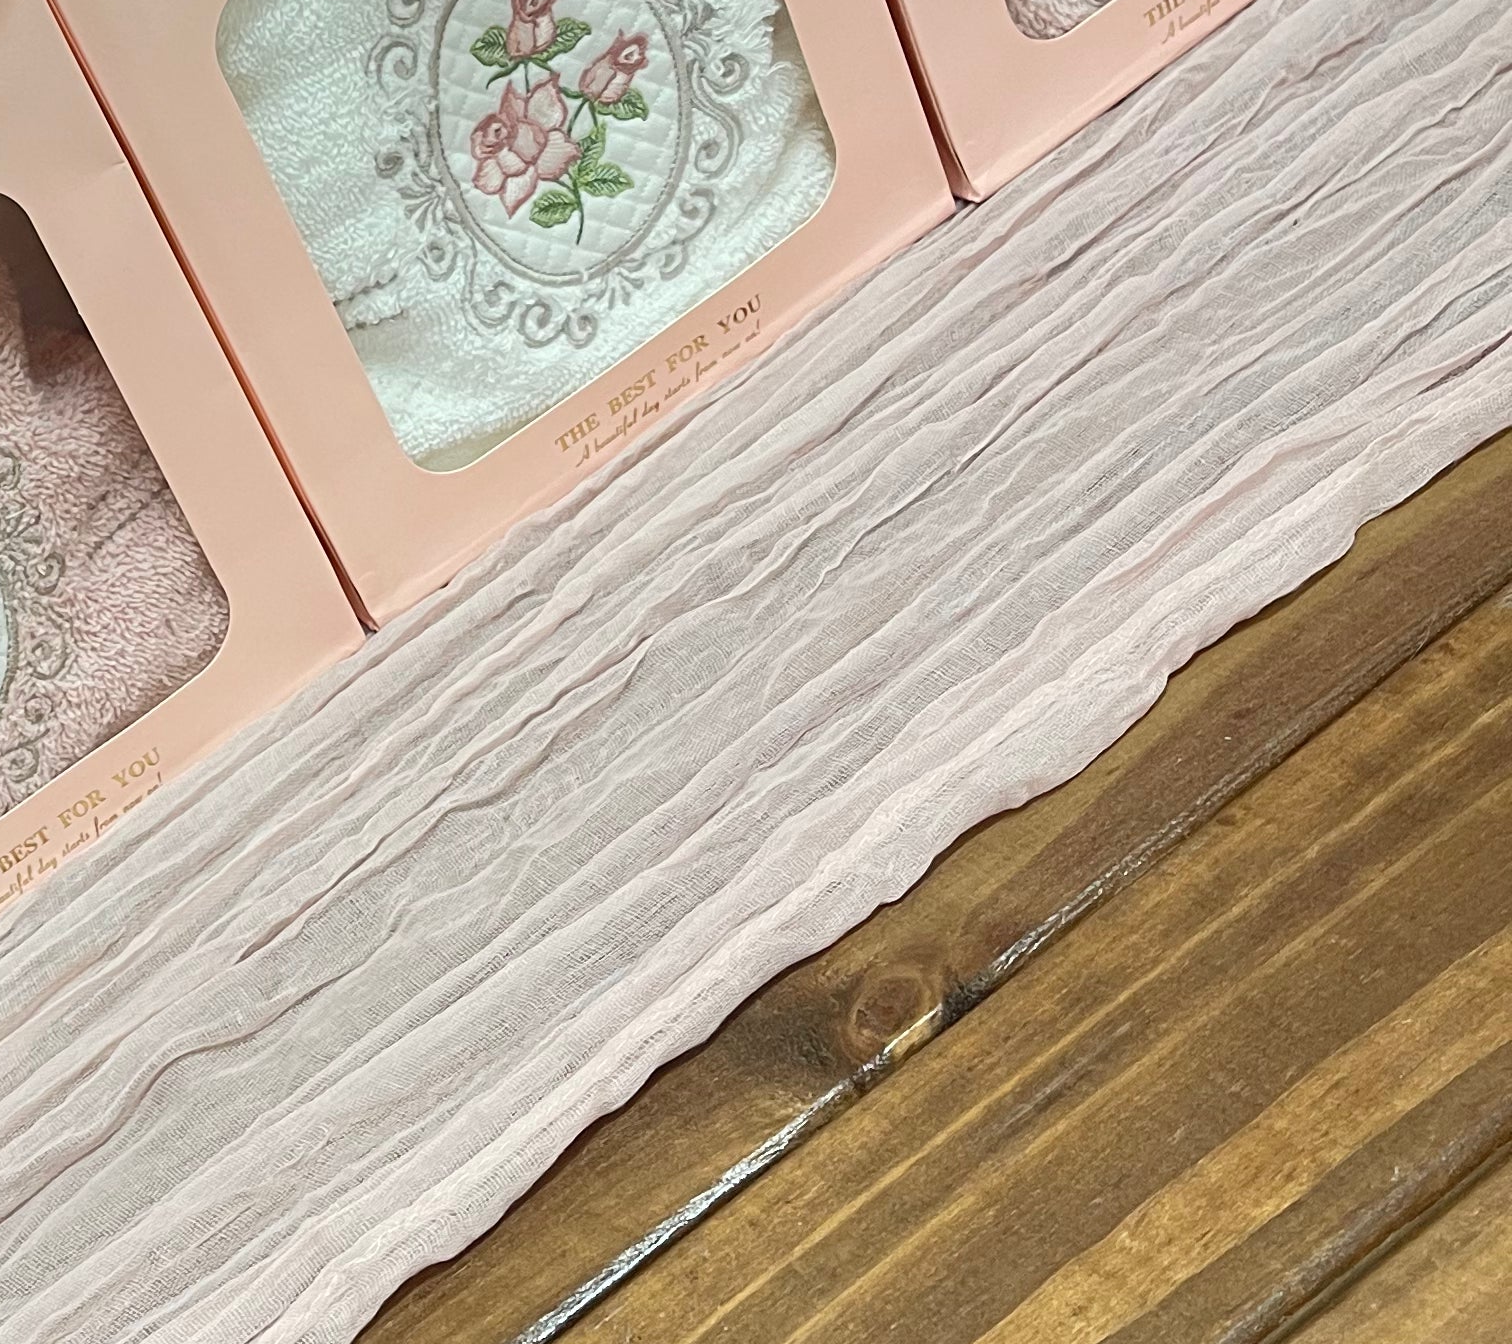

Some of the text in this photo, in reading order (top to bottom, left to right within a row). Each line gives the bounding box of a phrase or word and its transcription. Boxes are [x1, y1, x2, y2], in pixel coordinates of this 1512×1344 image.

[554, 293, 762, 452] THE BEST FOR YOU
[56, 789, 107, 830] FOR
[111, 747, 162, 789] YOU
